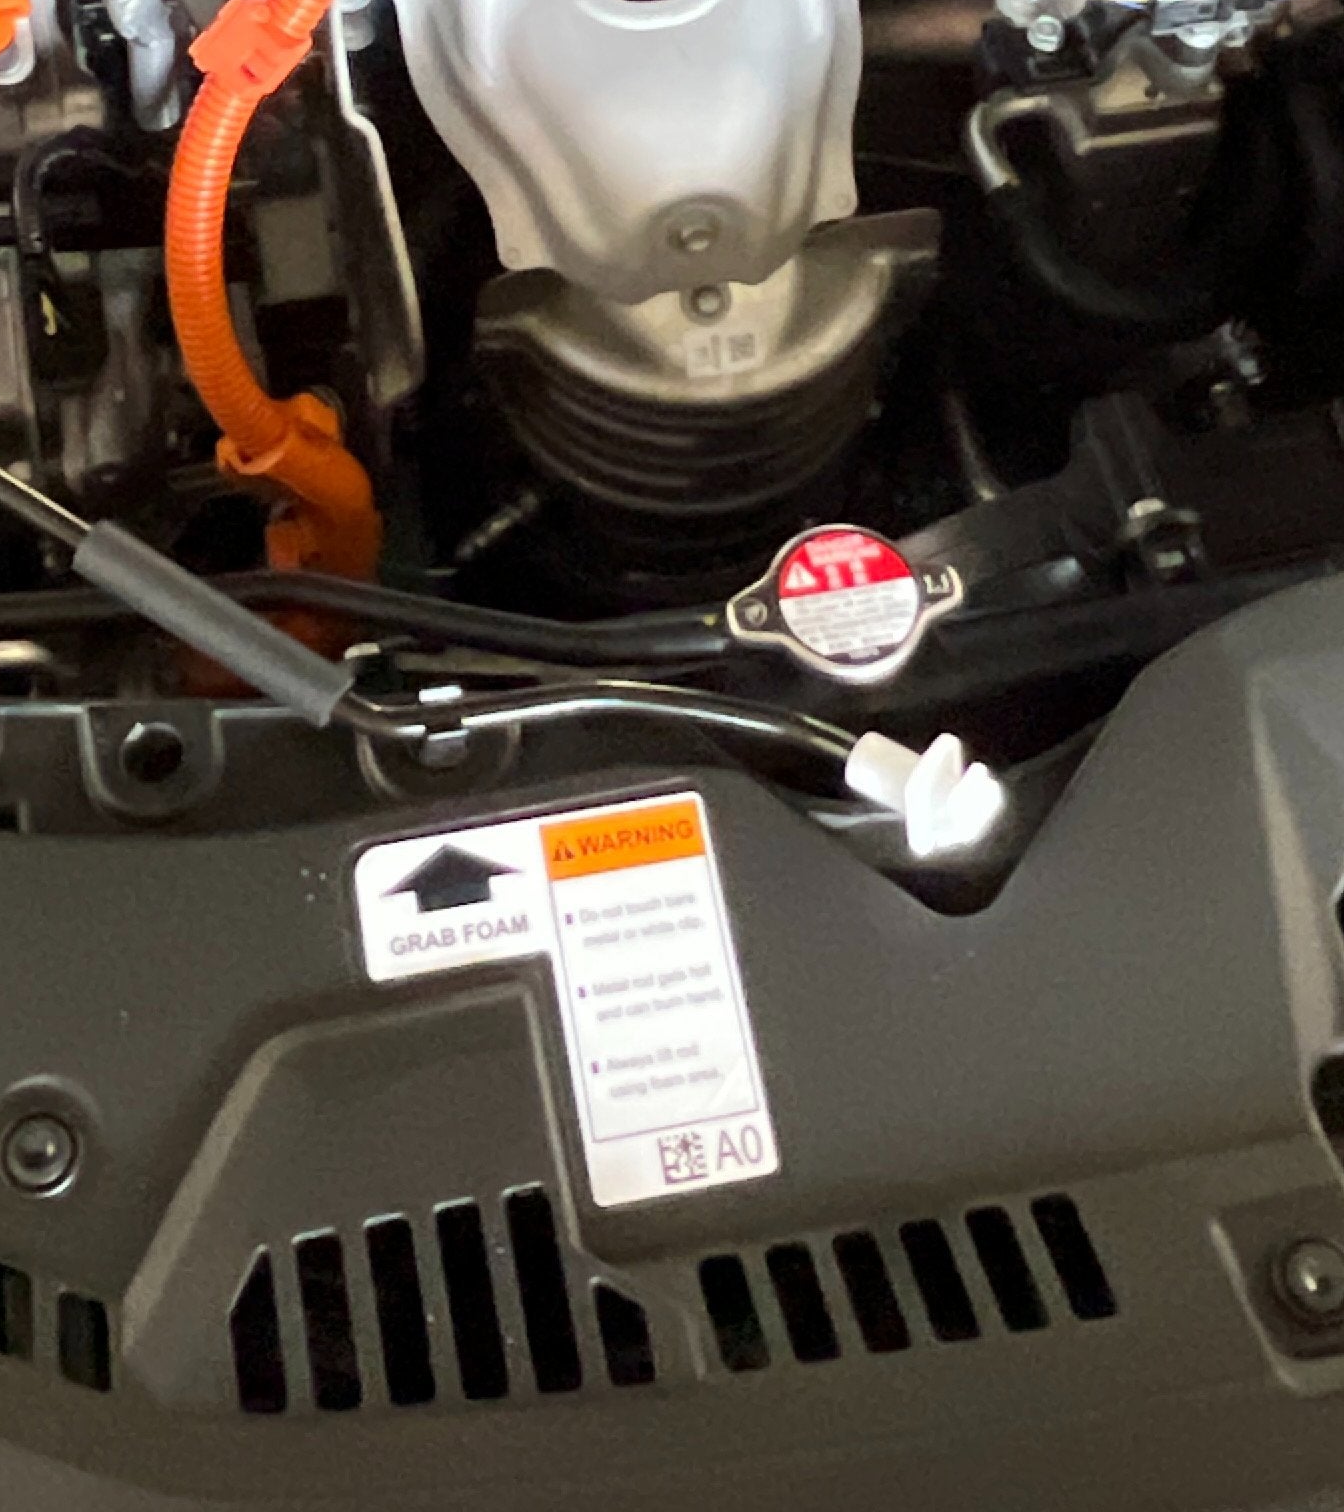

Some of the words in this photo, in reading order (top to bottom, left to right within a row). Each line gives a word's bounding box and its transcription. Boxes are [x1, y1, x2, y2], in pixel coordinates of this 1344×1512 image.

[579, 818, 696, 857] WARNING
[389, 927, 457, 956] GRAB
[463, 913, 530, 944] FOAM
